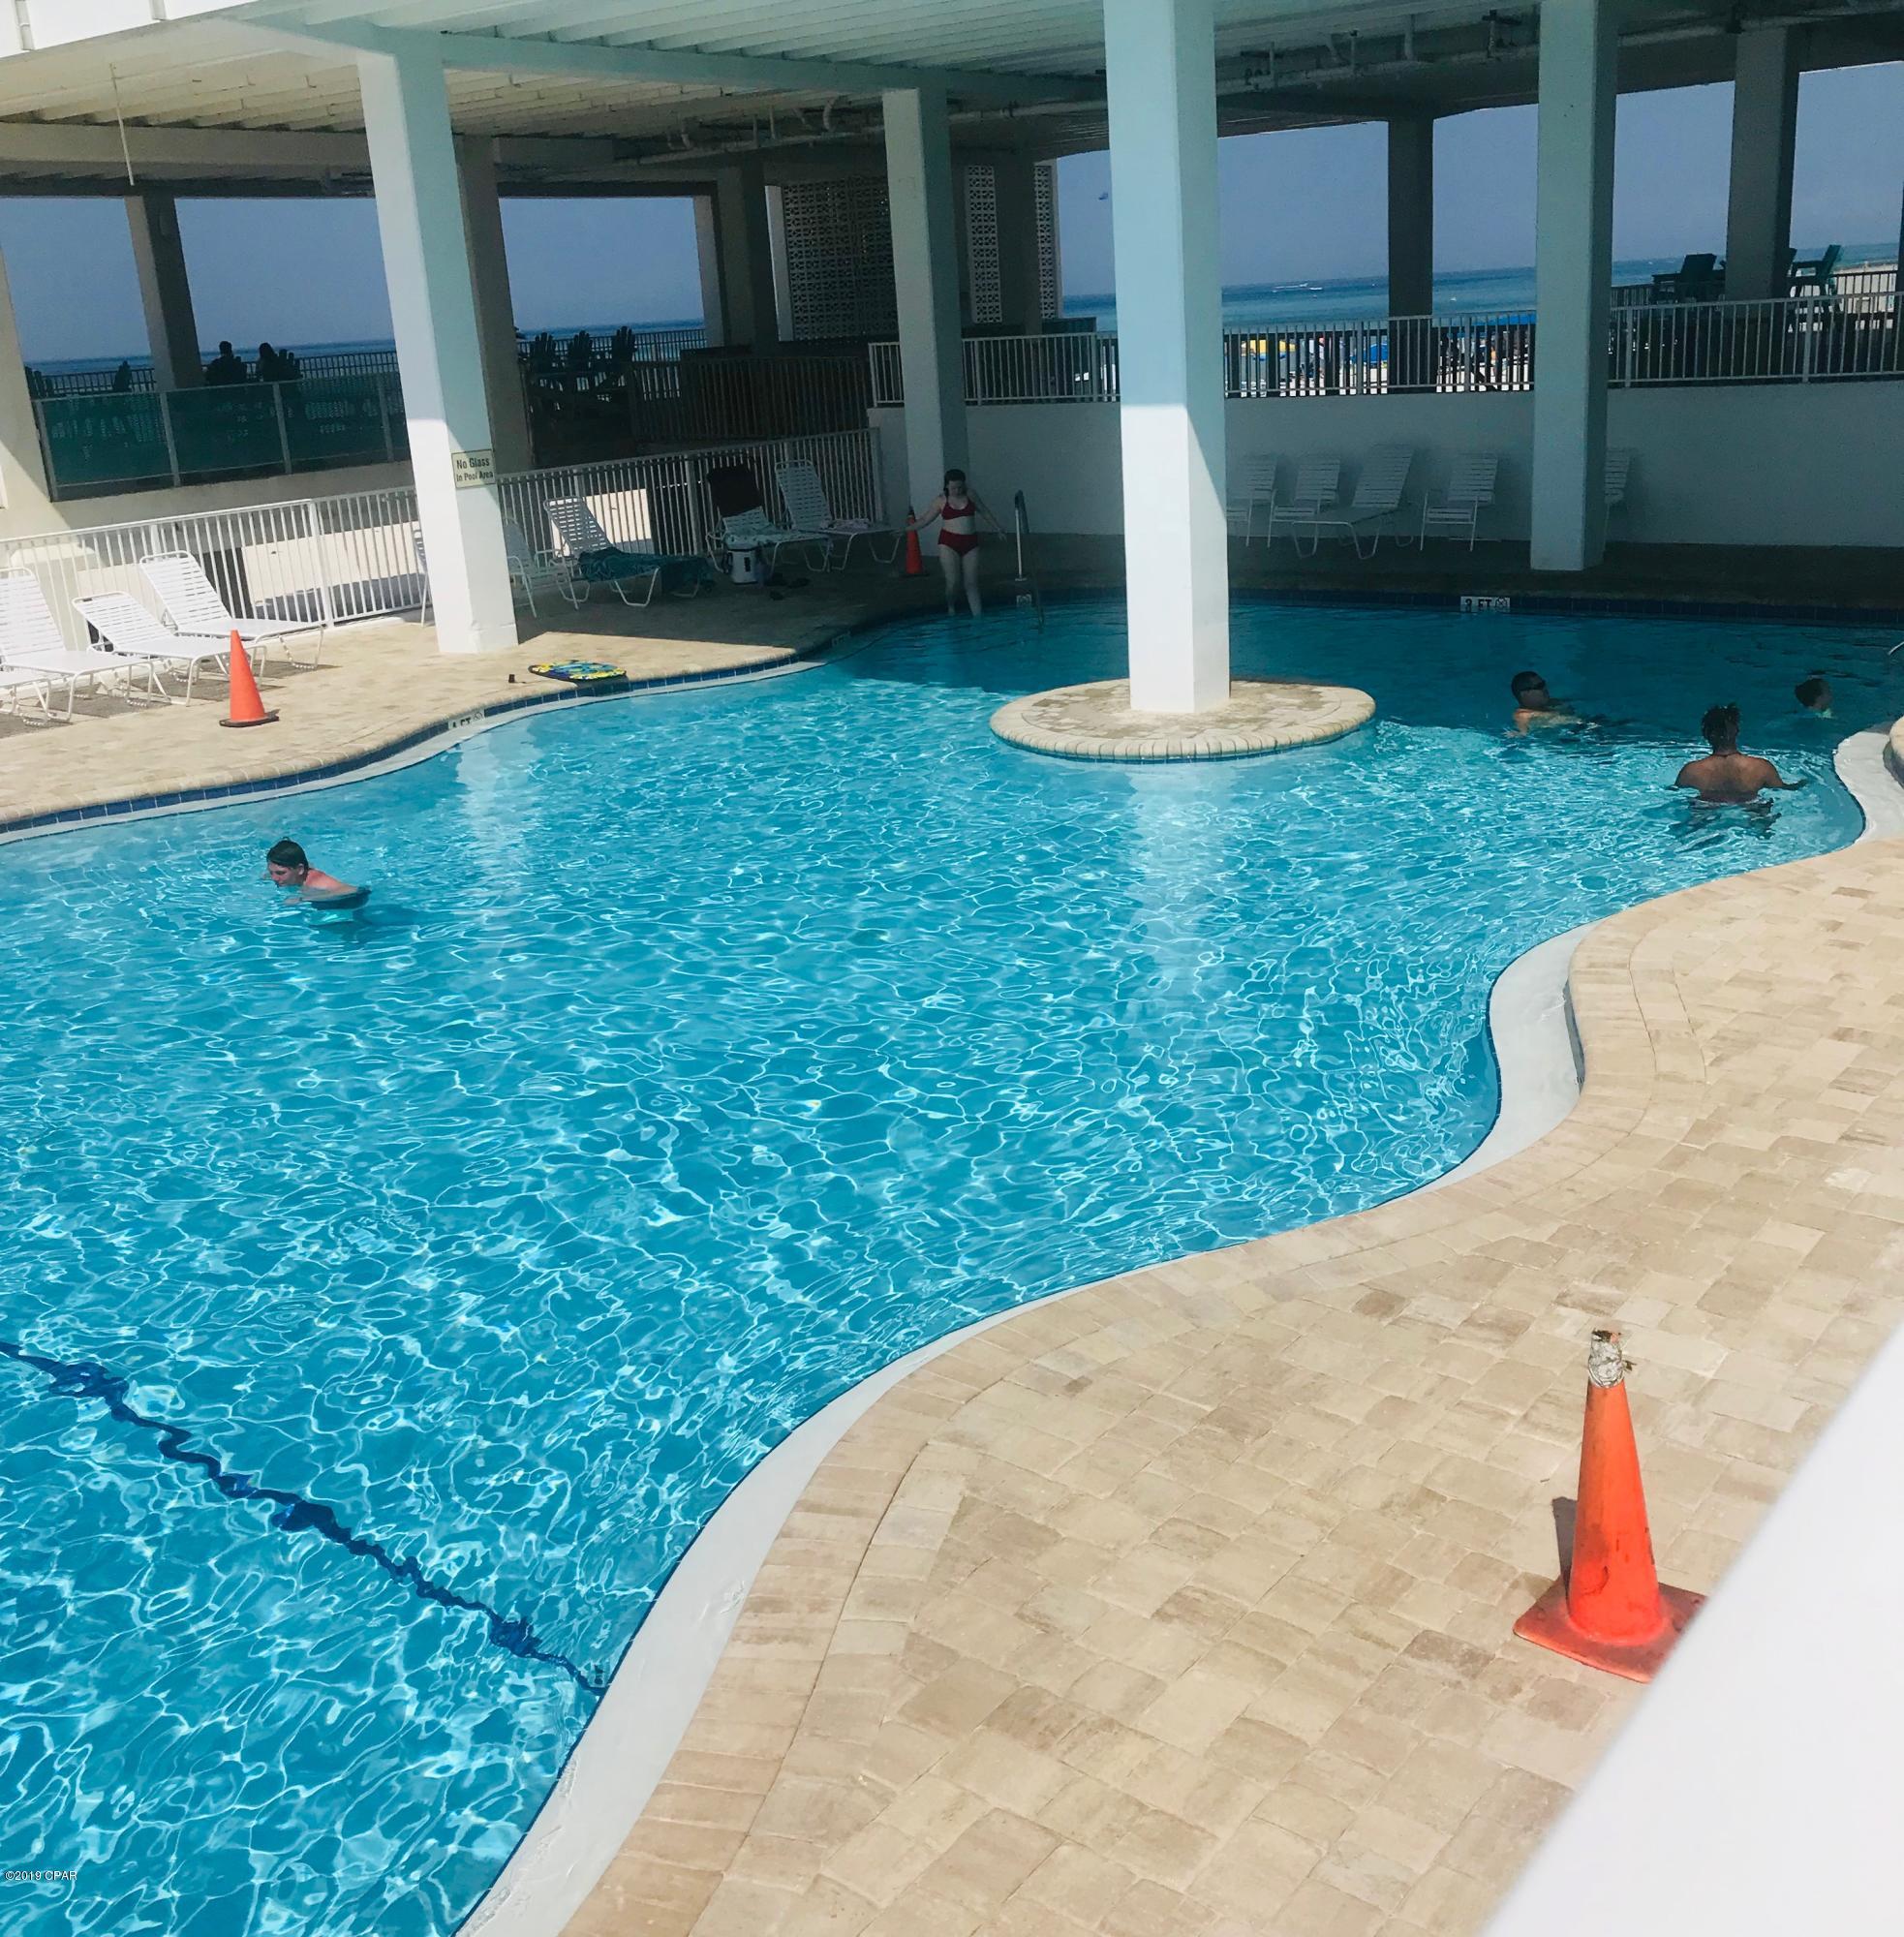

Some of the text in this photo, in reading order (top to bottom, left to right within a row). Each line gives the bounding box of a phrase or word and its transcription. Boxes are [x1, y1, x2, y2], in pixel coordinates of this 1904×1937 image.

[456, 457, 490, 470] No Glass
[456, 470, 494, 482] In Pool Area
